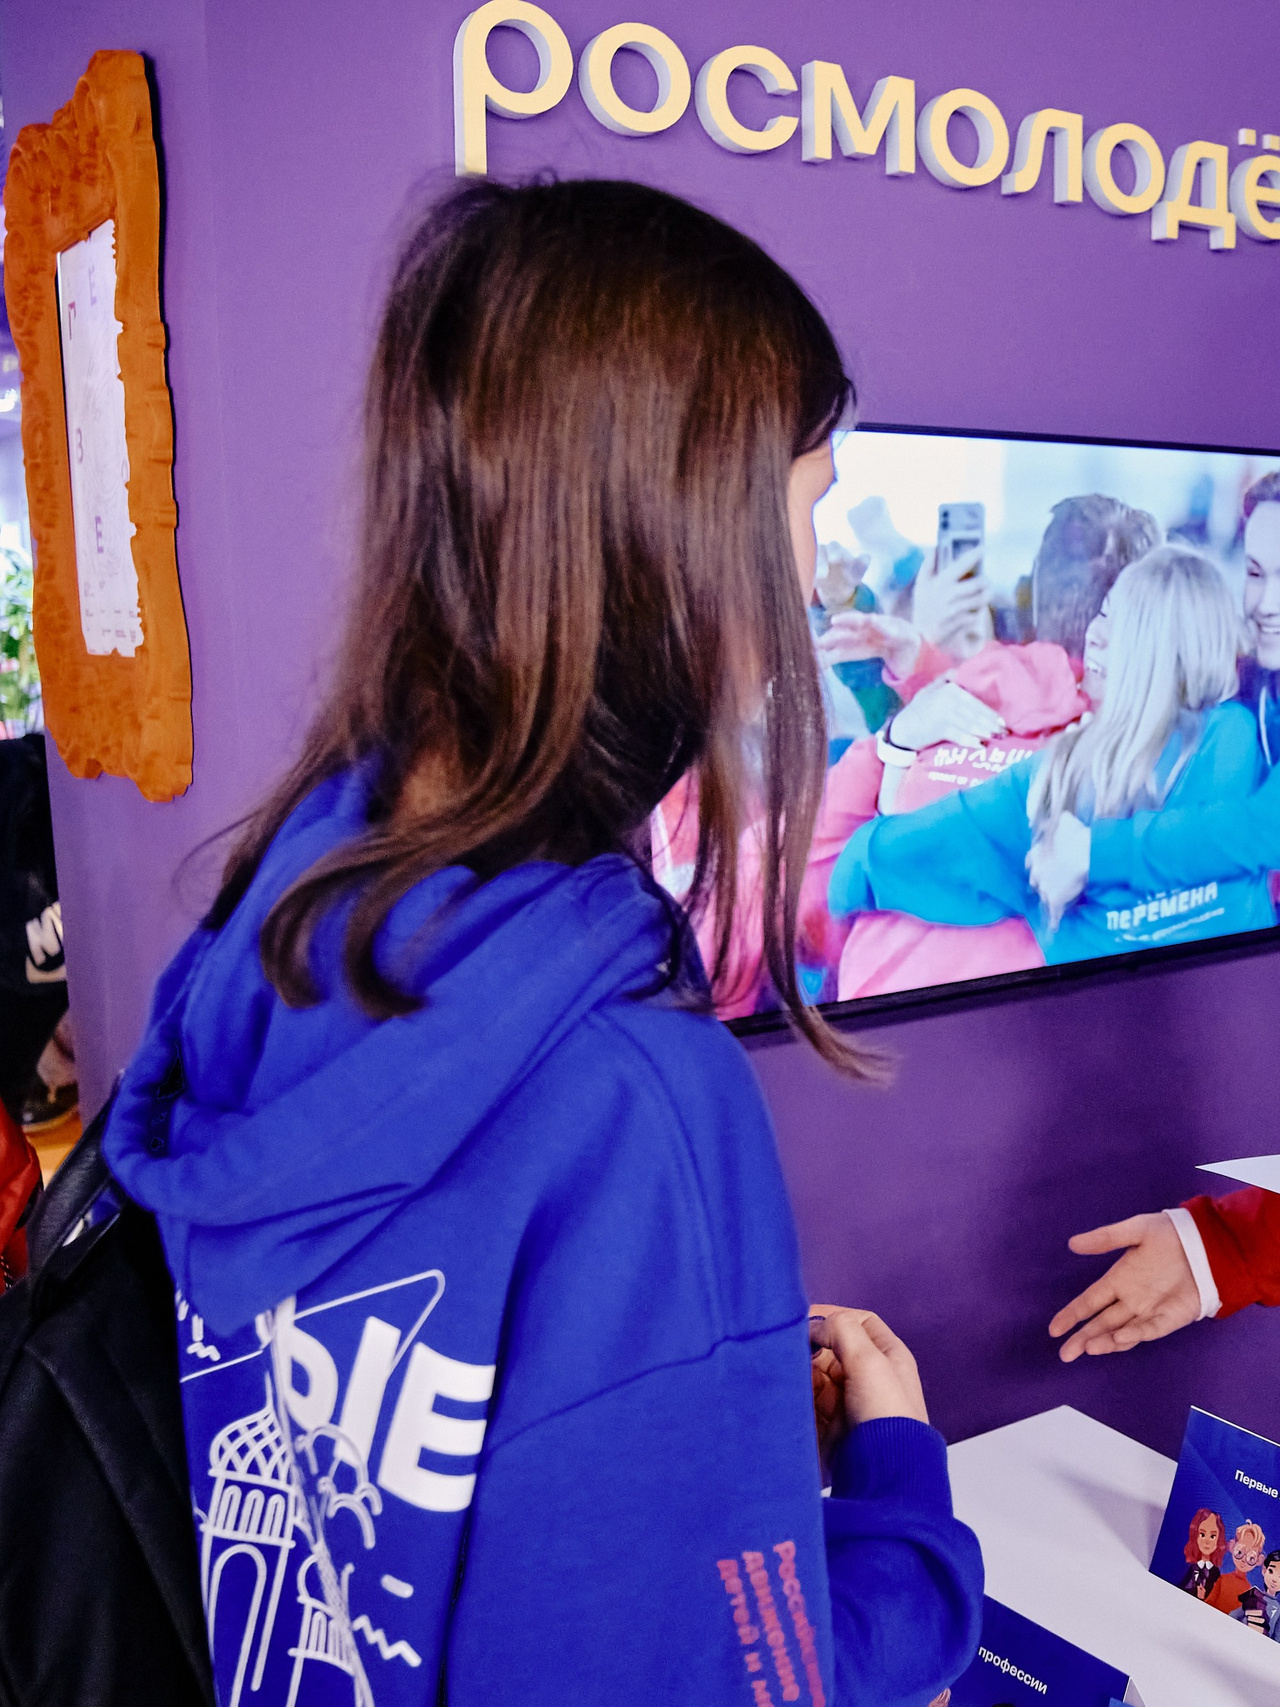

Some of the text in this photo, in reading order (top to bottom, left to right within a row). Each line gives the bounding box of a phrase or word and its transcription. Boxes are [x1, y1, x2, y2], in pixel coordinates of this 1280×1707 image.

[1106, 881, 1218, 931] ПЕРЕМЕНА
[1234, 1469, 1279, 1499] Первые
[978, 1646, 1048, 1695] профессии
